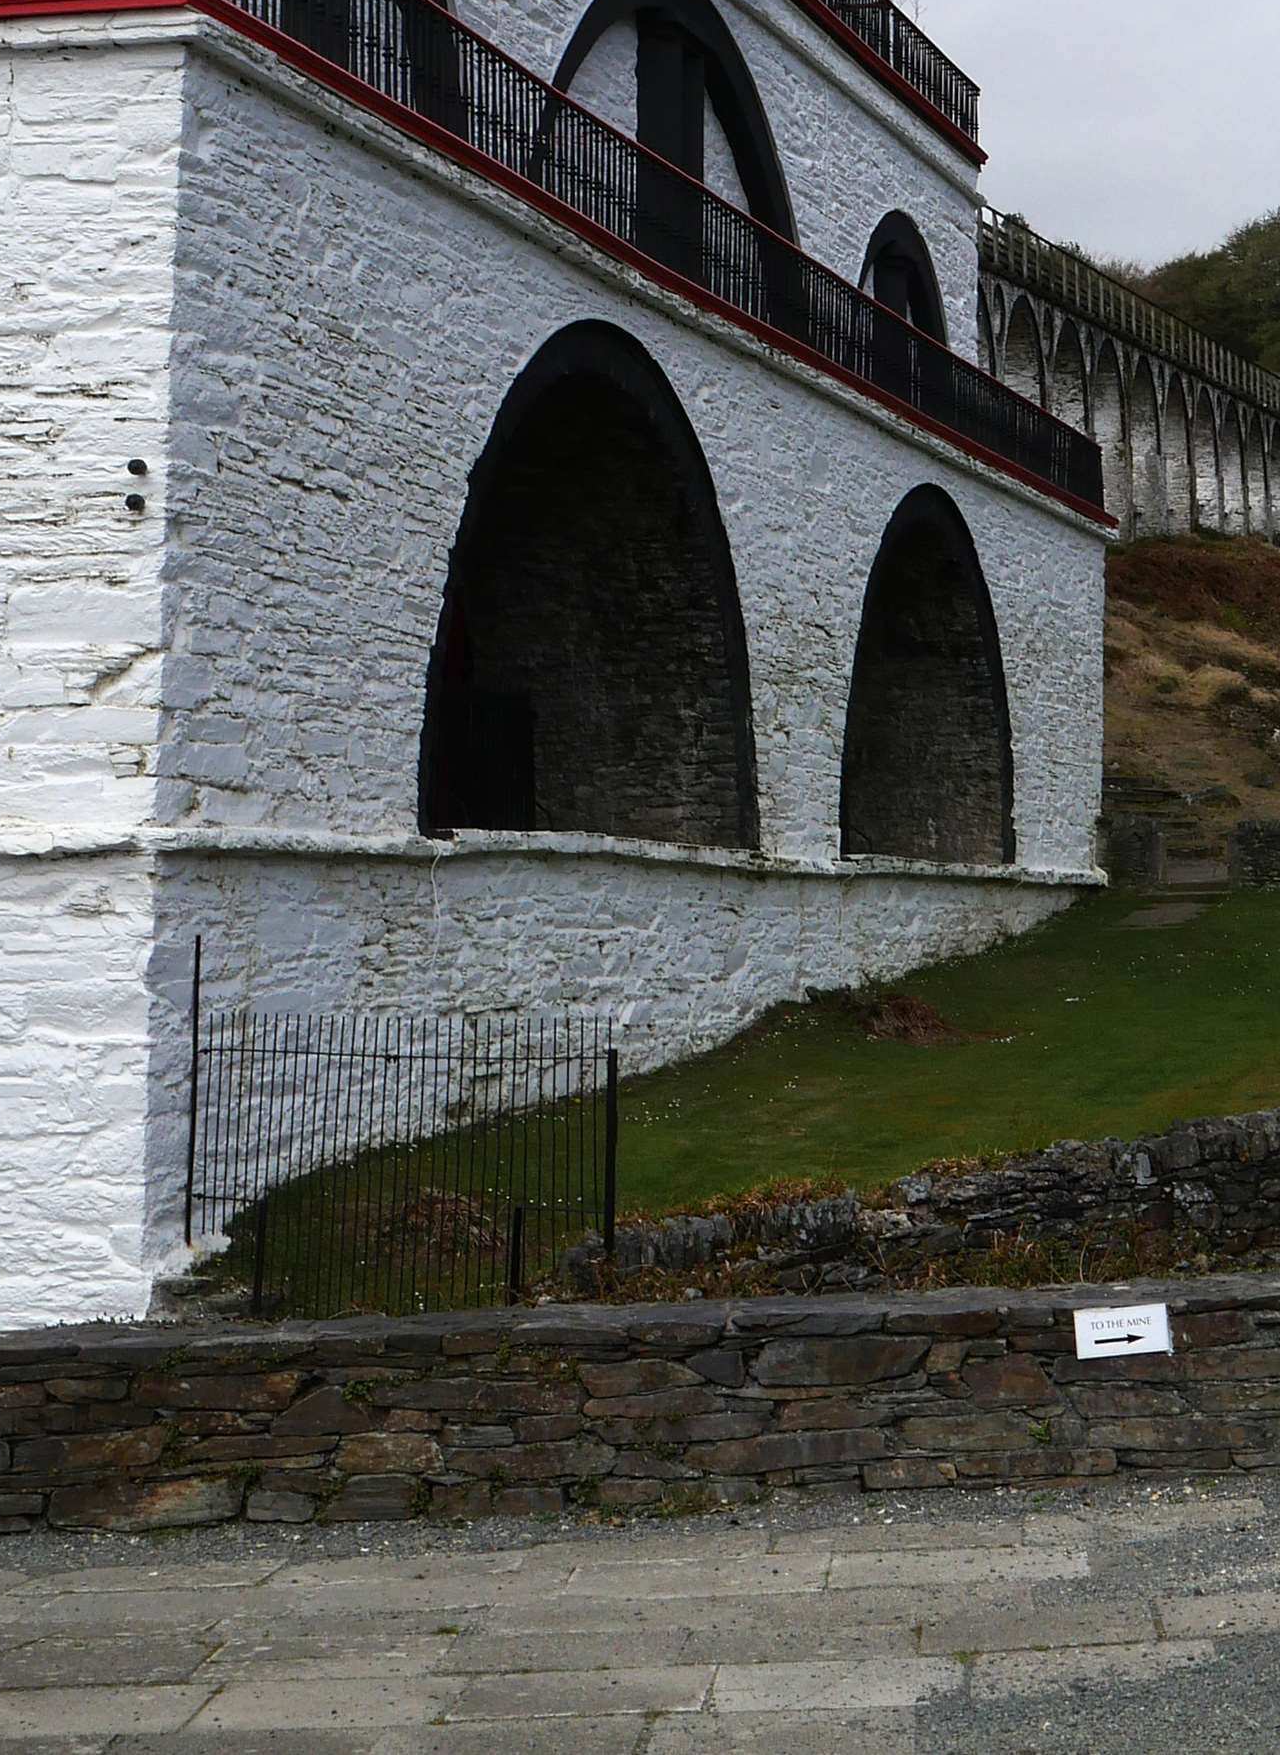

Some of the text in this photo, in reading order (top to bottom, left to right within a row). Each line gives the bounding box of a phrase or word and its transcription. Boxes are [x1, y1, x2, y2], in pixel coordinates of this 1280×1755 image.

[1091, 1316, 1152, 1330] TO THE MINE
